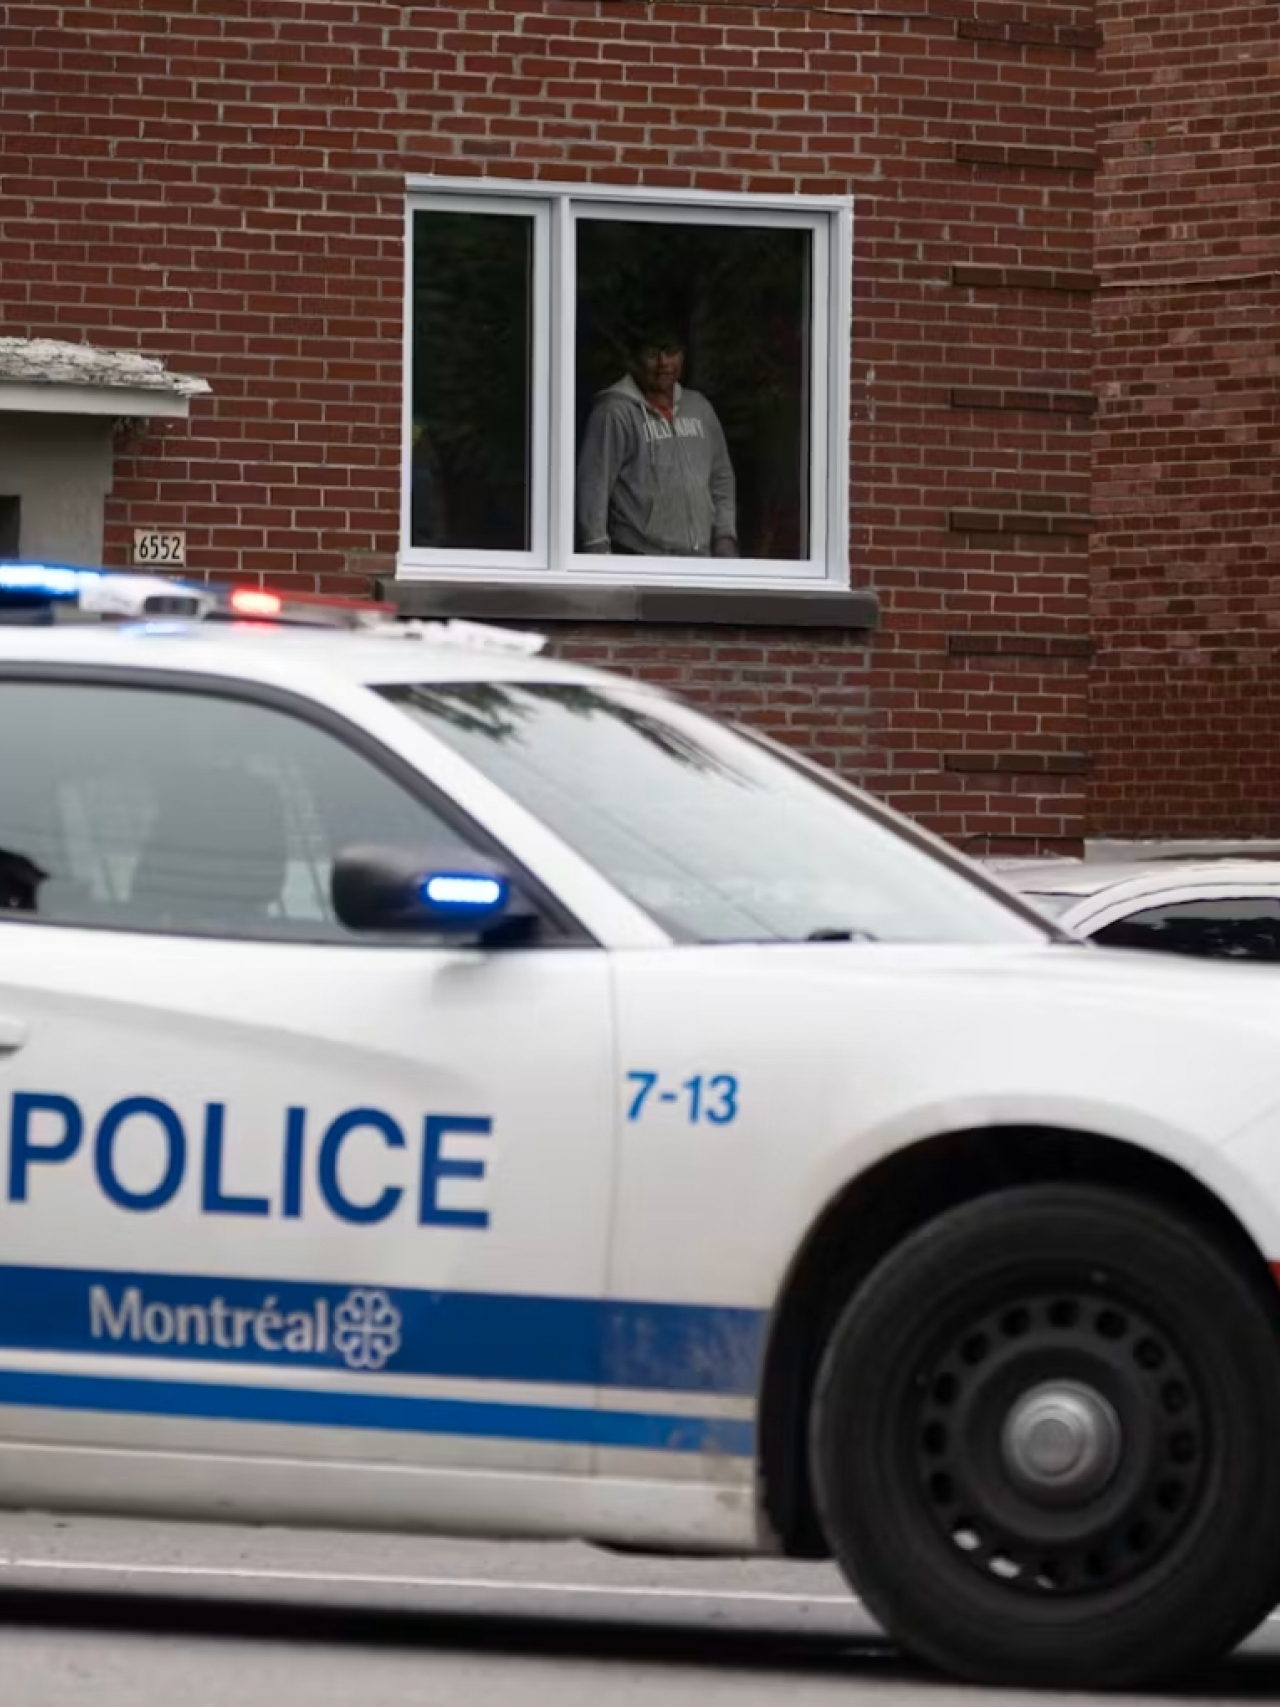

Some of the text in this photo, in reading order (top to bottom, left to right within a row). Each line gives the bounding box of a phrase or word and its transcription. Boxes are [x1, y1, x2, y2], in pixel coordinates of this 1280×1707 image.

[139, 535, 180, 560] 6552
[627, 1069, 740, 1126] 7-13
[8, 1091, 493, 1228] POLICE
[89, 1285, 328, 1352] Montréal
